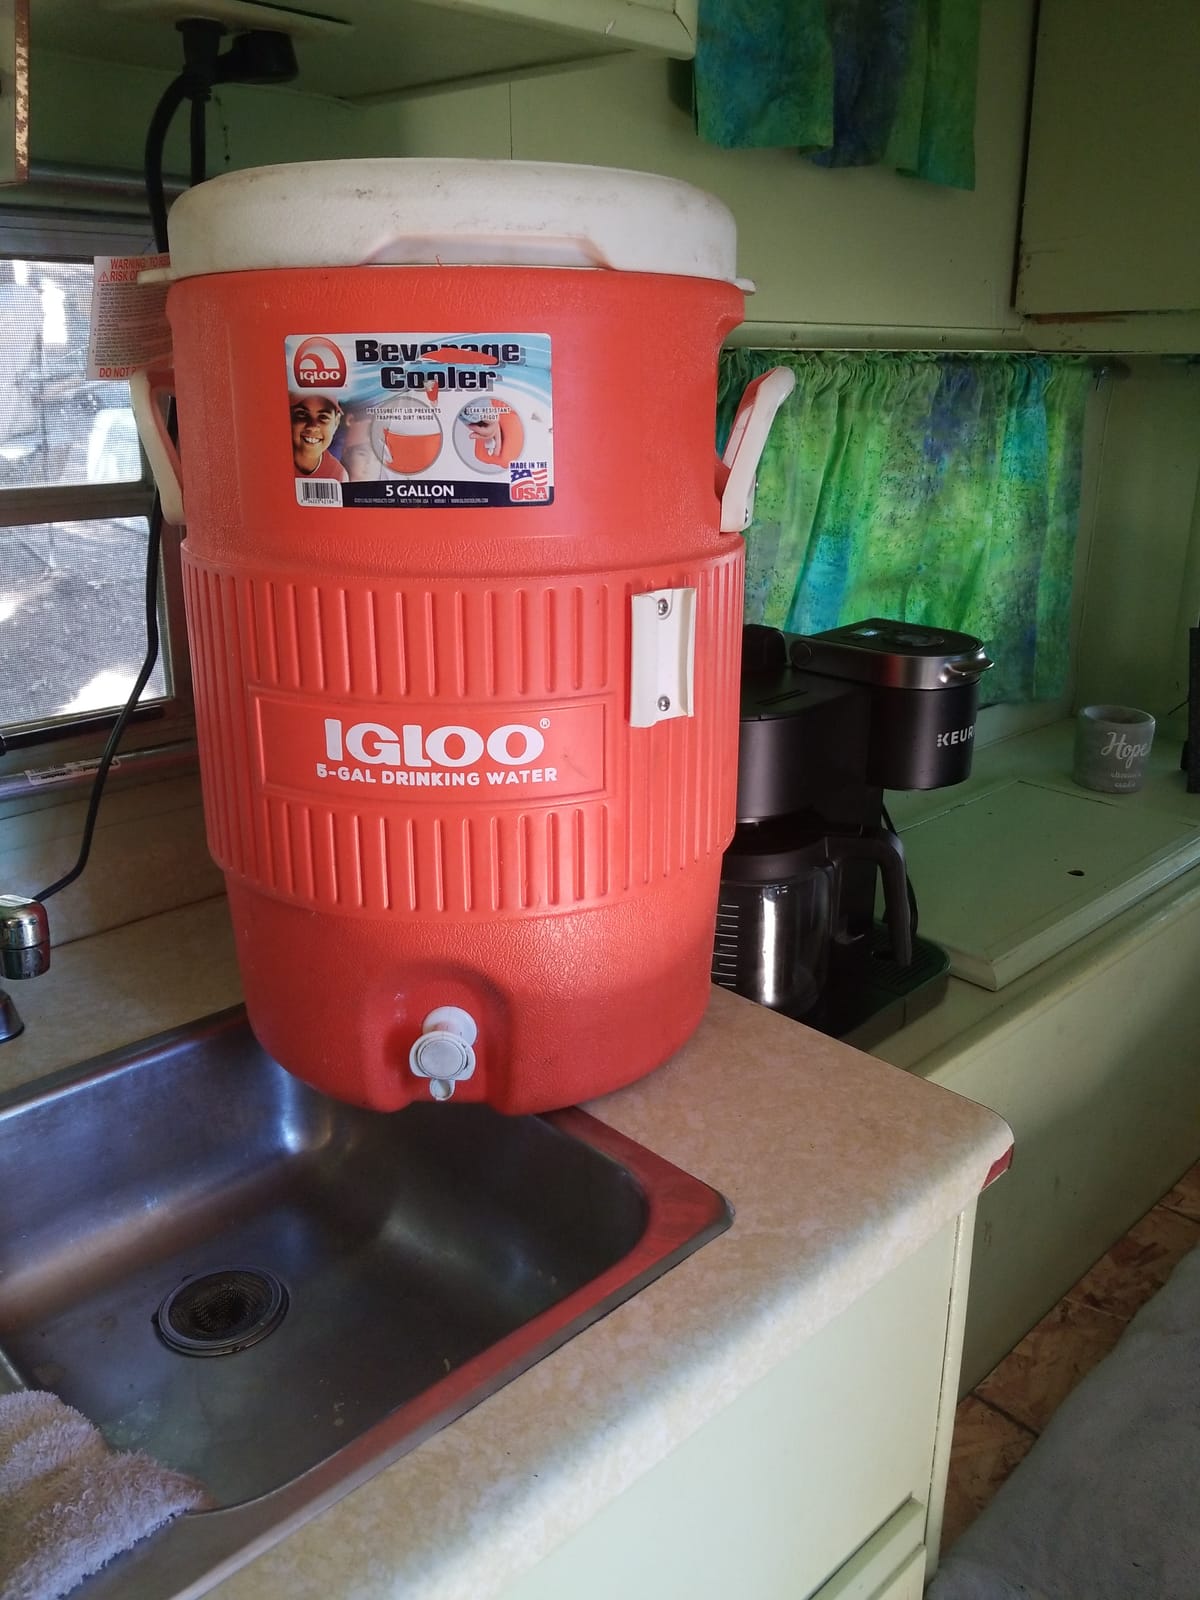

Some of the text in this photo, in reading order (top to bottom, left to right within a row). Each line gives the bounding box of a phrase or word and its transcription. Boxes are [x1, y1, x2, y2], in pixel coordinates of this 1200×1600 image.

[110, 270, 128, 281] RISK
[99, 367, 112, 377] DO
[114, 366, 130, 377] NOT
[300, 371, 340, 384] IGLOO
[381, 367, 497, 389] Cooler
[510, 461, 548, 469] MADE IN THE
[386, 485, 455, 497] 5 GALLON
[511, 486, 548, 501] USA
[325, 718, 545, 767] IGLOO
[937, 726, 974, 747] KEUR
[1101, 732, 1150, 768] Hope
[316, 763, 558, 787] 5-GAL DRINKING WATER
